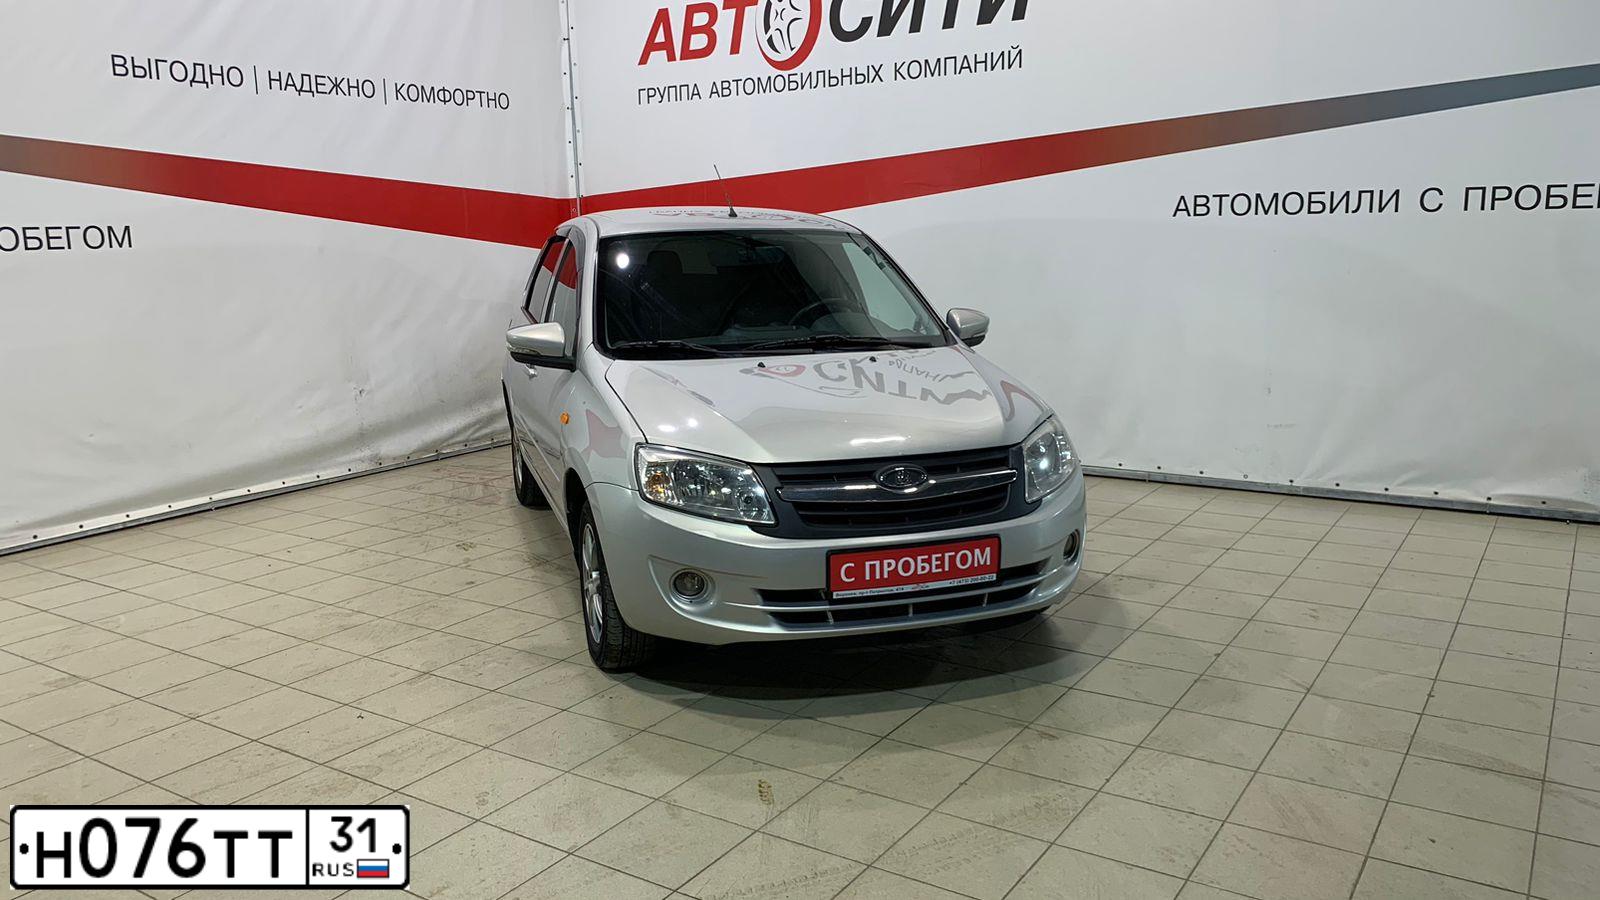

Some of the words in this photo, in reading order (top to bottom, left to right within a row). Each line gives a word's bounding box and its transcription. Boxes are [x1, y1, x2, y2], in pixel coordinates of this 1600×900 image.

[110, 54, 244, 89] ВЫГОДНО
[267, 70, 376, 99] НАДЕЖНО
[394, 82, 510, 110] КОМФОРТНО
[637, 83, 702, 105] ГРУППА
[708, 61, 884, 99] АВТОМОБИЛЬНЫХ
[893, 44, 1023, 82] КОМПАНИЙ
[1172, 188, 1400, 218] АВТОМОБИЛИ
[1419, 187, 1444, 213] С
[1463, 183, 1600, 212] ПРОБЕ
[0, 225, 133, 252] ОБЕГОМ
[840, 562, 856, 583] С
[865, 546, 991, 581] ПРОБЕГОМ
